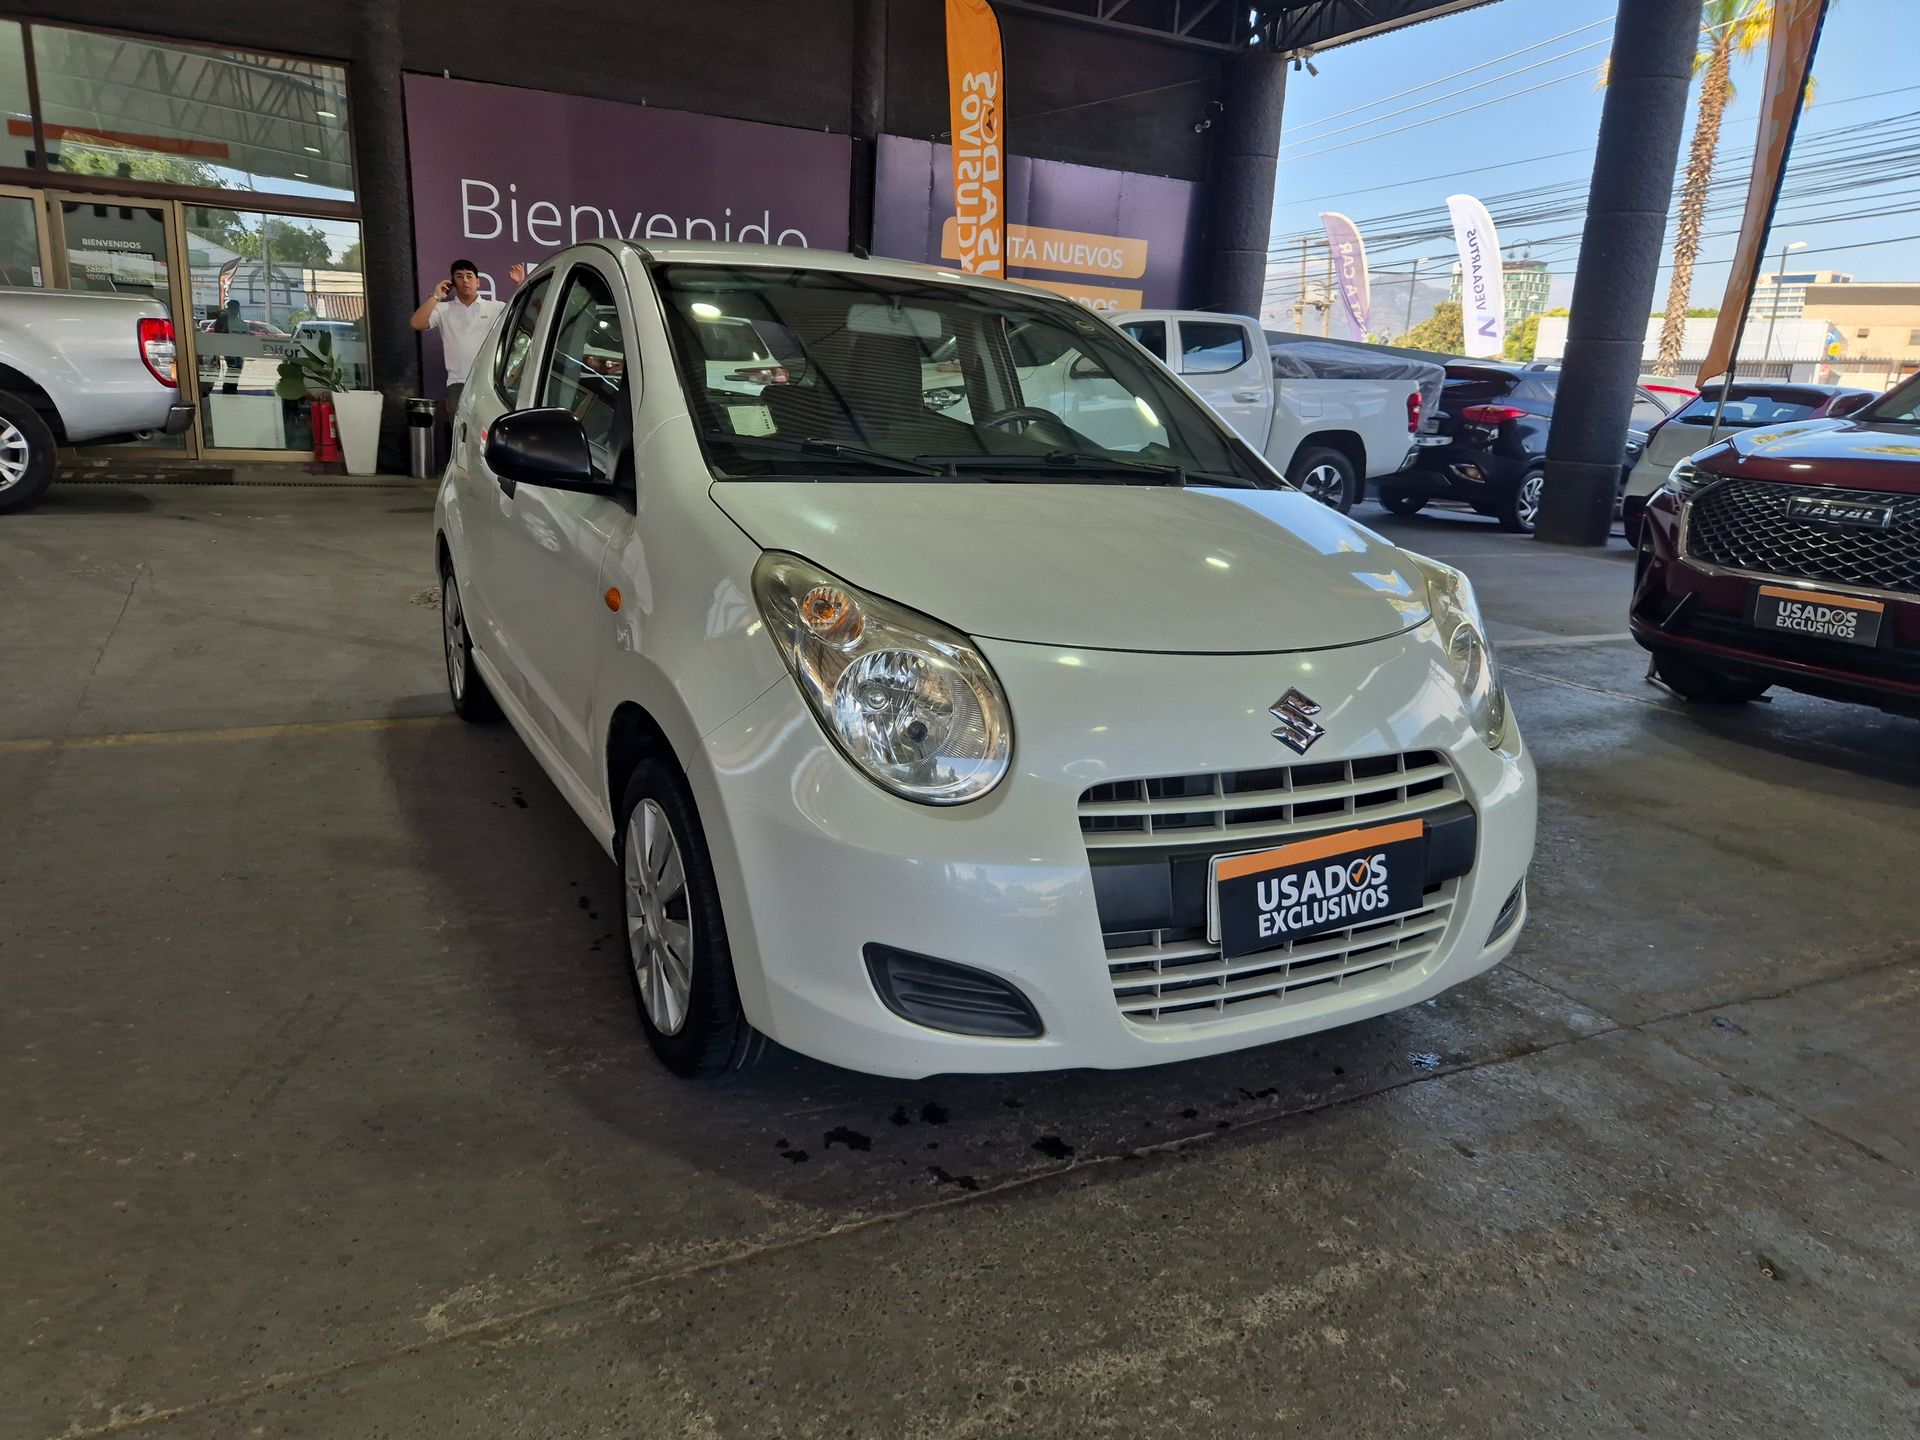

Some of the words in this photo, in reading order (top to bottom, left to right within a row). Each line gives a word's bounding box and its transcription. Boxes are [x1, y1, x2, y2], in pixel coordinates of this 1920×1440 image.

[461, 178, 808, 250] Bienvenido
[81, 238, 141, 249] BIENVENIDOS
[1043, 241, 1124, 269] NUEVOS
[1776, 615, 1855, 639] EXCLUSIVOS
[1778, 601, 1858, 627] USADOS
[1257, 853, 1388, 912] USADOS
[1258, 885, 1390, 938] EXCLUSIVOS
